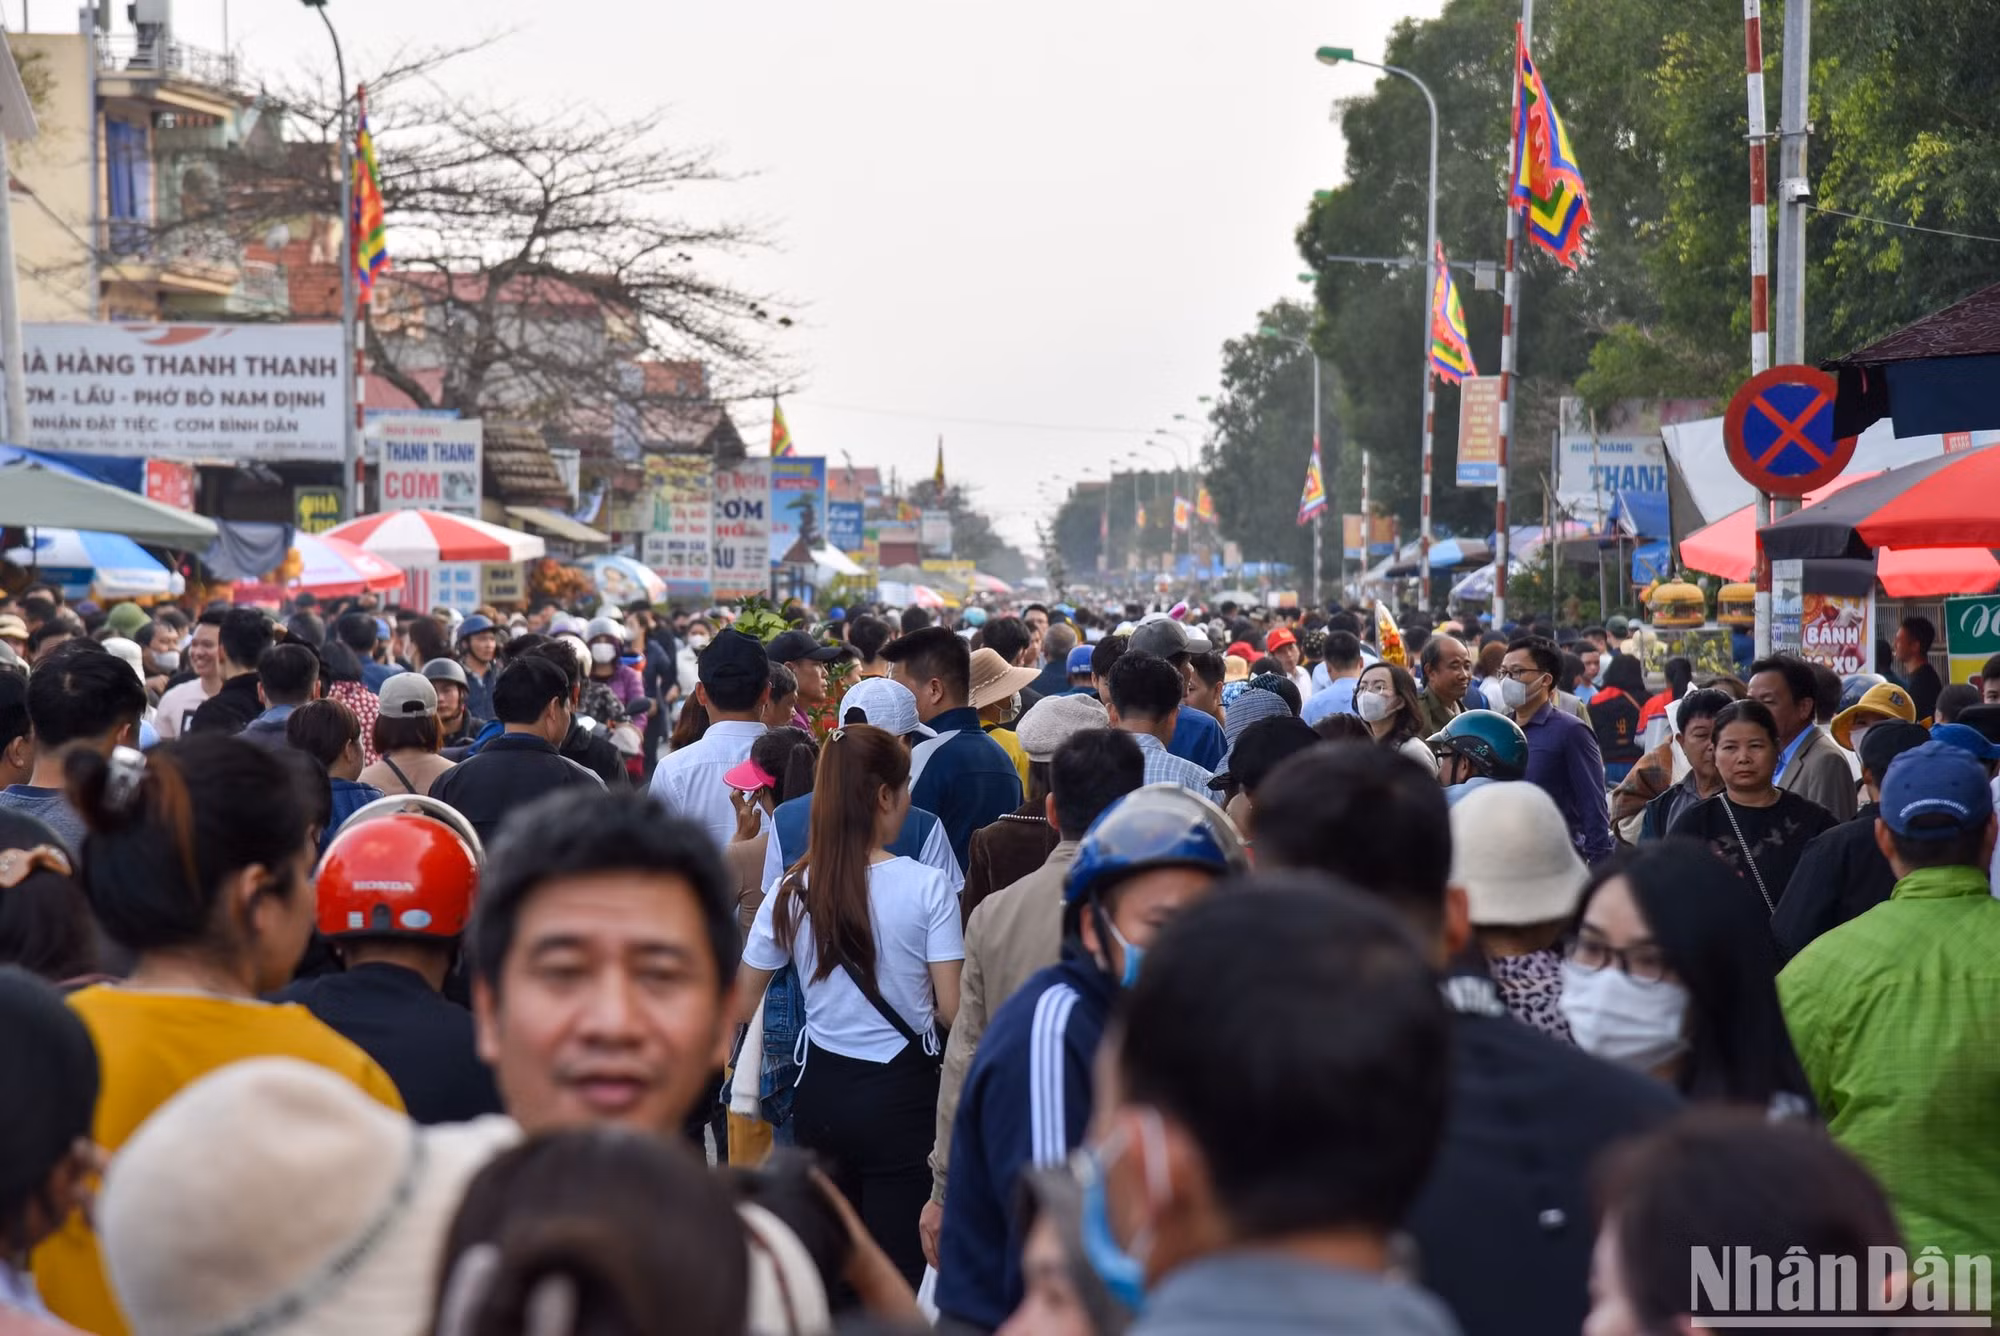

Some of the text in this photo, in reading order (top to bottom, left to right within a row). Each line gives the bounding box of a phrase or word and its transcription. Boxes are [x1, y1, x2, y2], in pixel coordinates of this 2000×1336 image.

[56, 345, 135, 376] HÀNG
[143, 354, 236, 377] THANH
[244, 356, 338, 378] THANH
[185, 386, 215, 407] BÒ
[220, 391, 268, 408] NAM
[274, 391, 326, 413] ĐỊNH
[174, 417, 215, 433] CƠM
[386, 441, 475, 463] THANH THANH
[384, 468, 440, 501] CƠM
[1806, 622, 1859, 646] BÁNH
[1832, 655, 1859, 674] XU
[352, 880, 415, 893] HONDA
